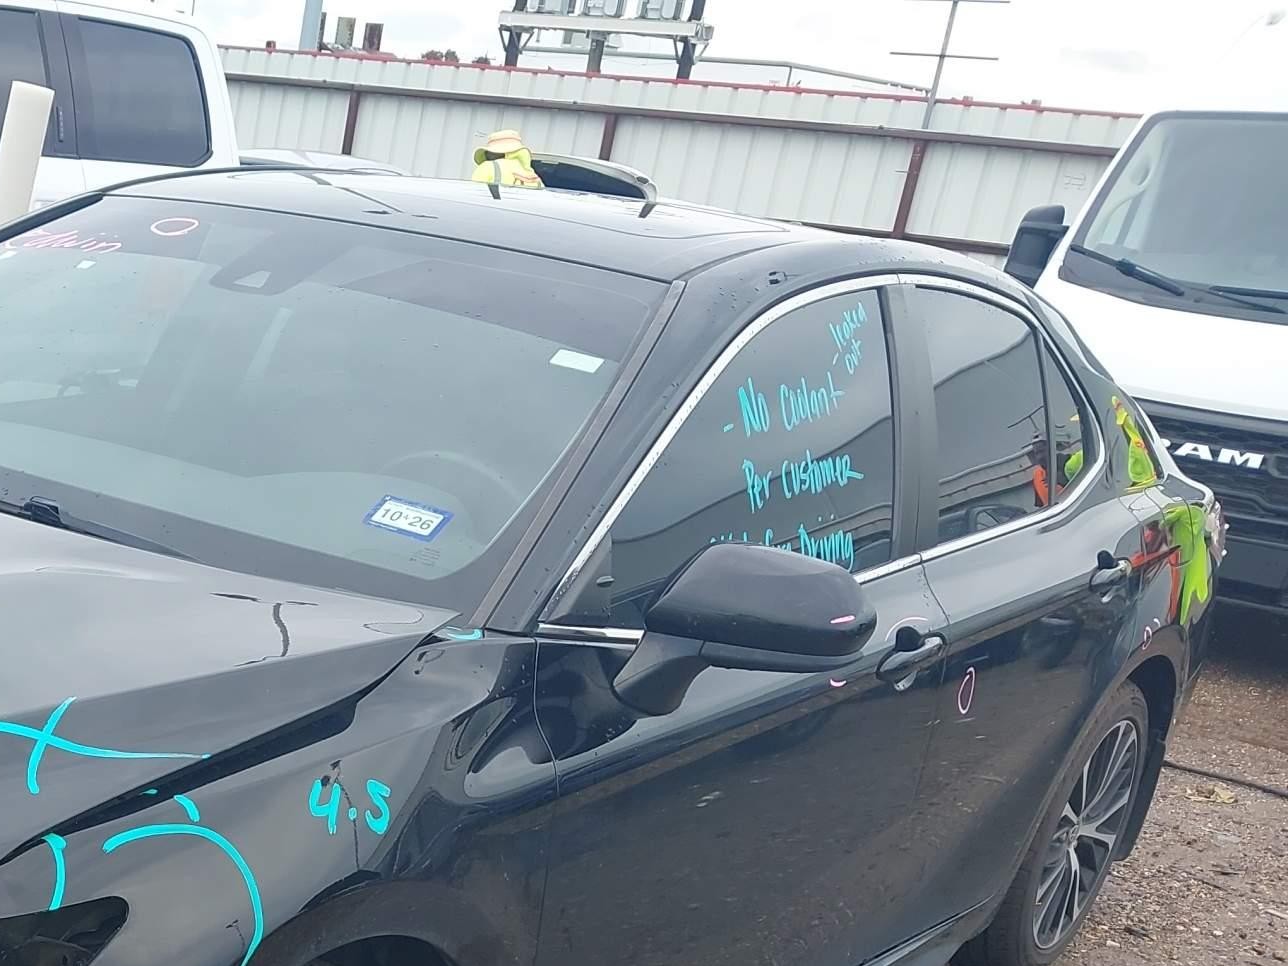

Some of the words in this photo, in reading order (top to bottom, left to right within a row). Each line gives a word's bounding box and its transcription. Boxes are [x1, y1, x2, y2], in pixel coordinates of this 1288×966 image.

[738, 376, 770, 438] No
[1159, 438, 1265, 469] AM
[741, 458, 773, 514] Per
[309, 777, 392, 835] 4.5
